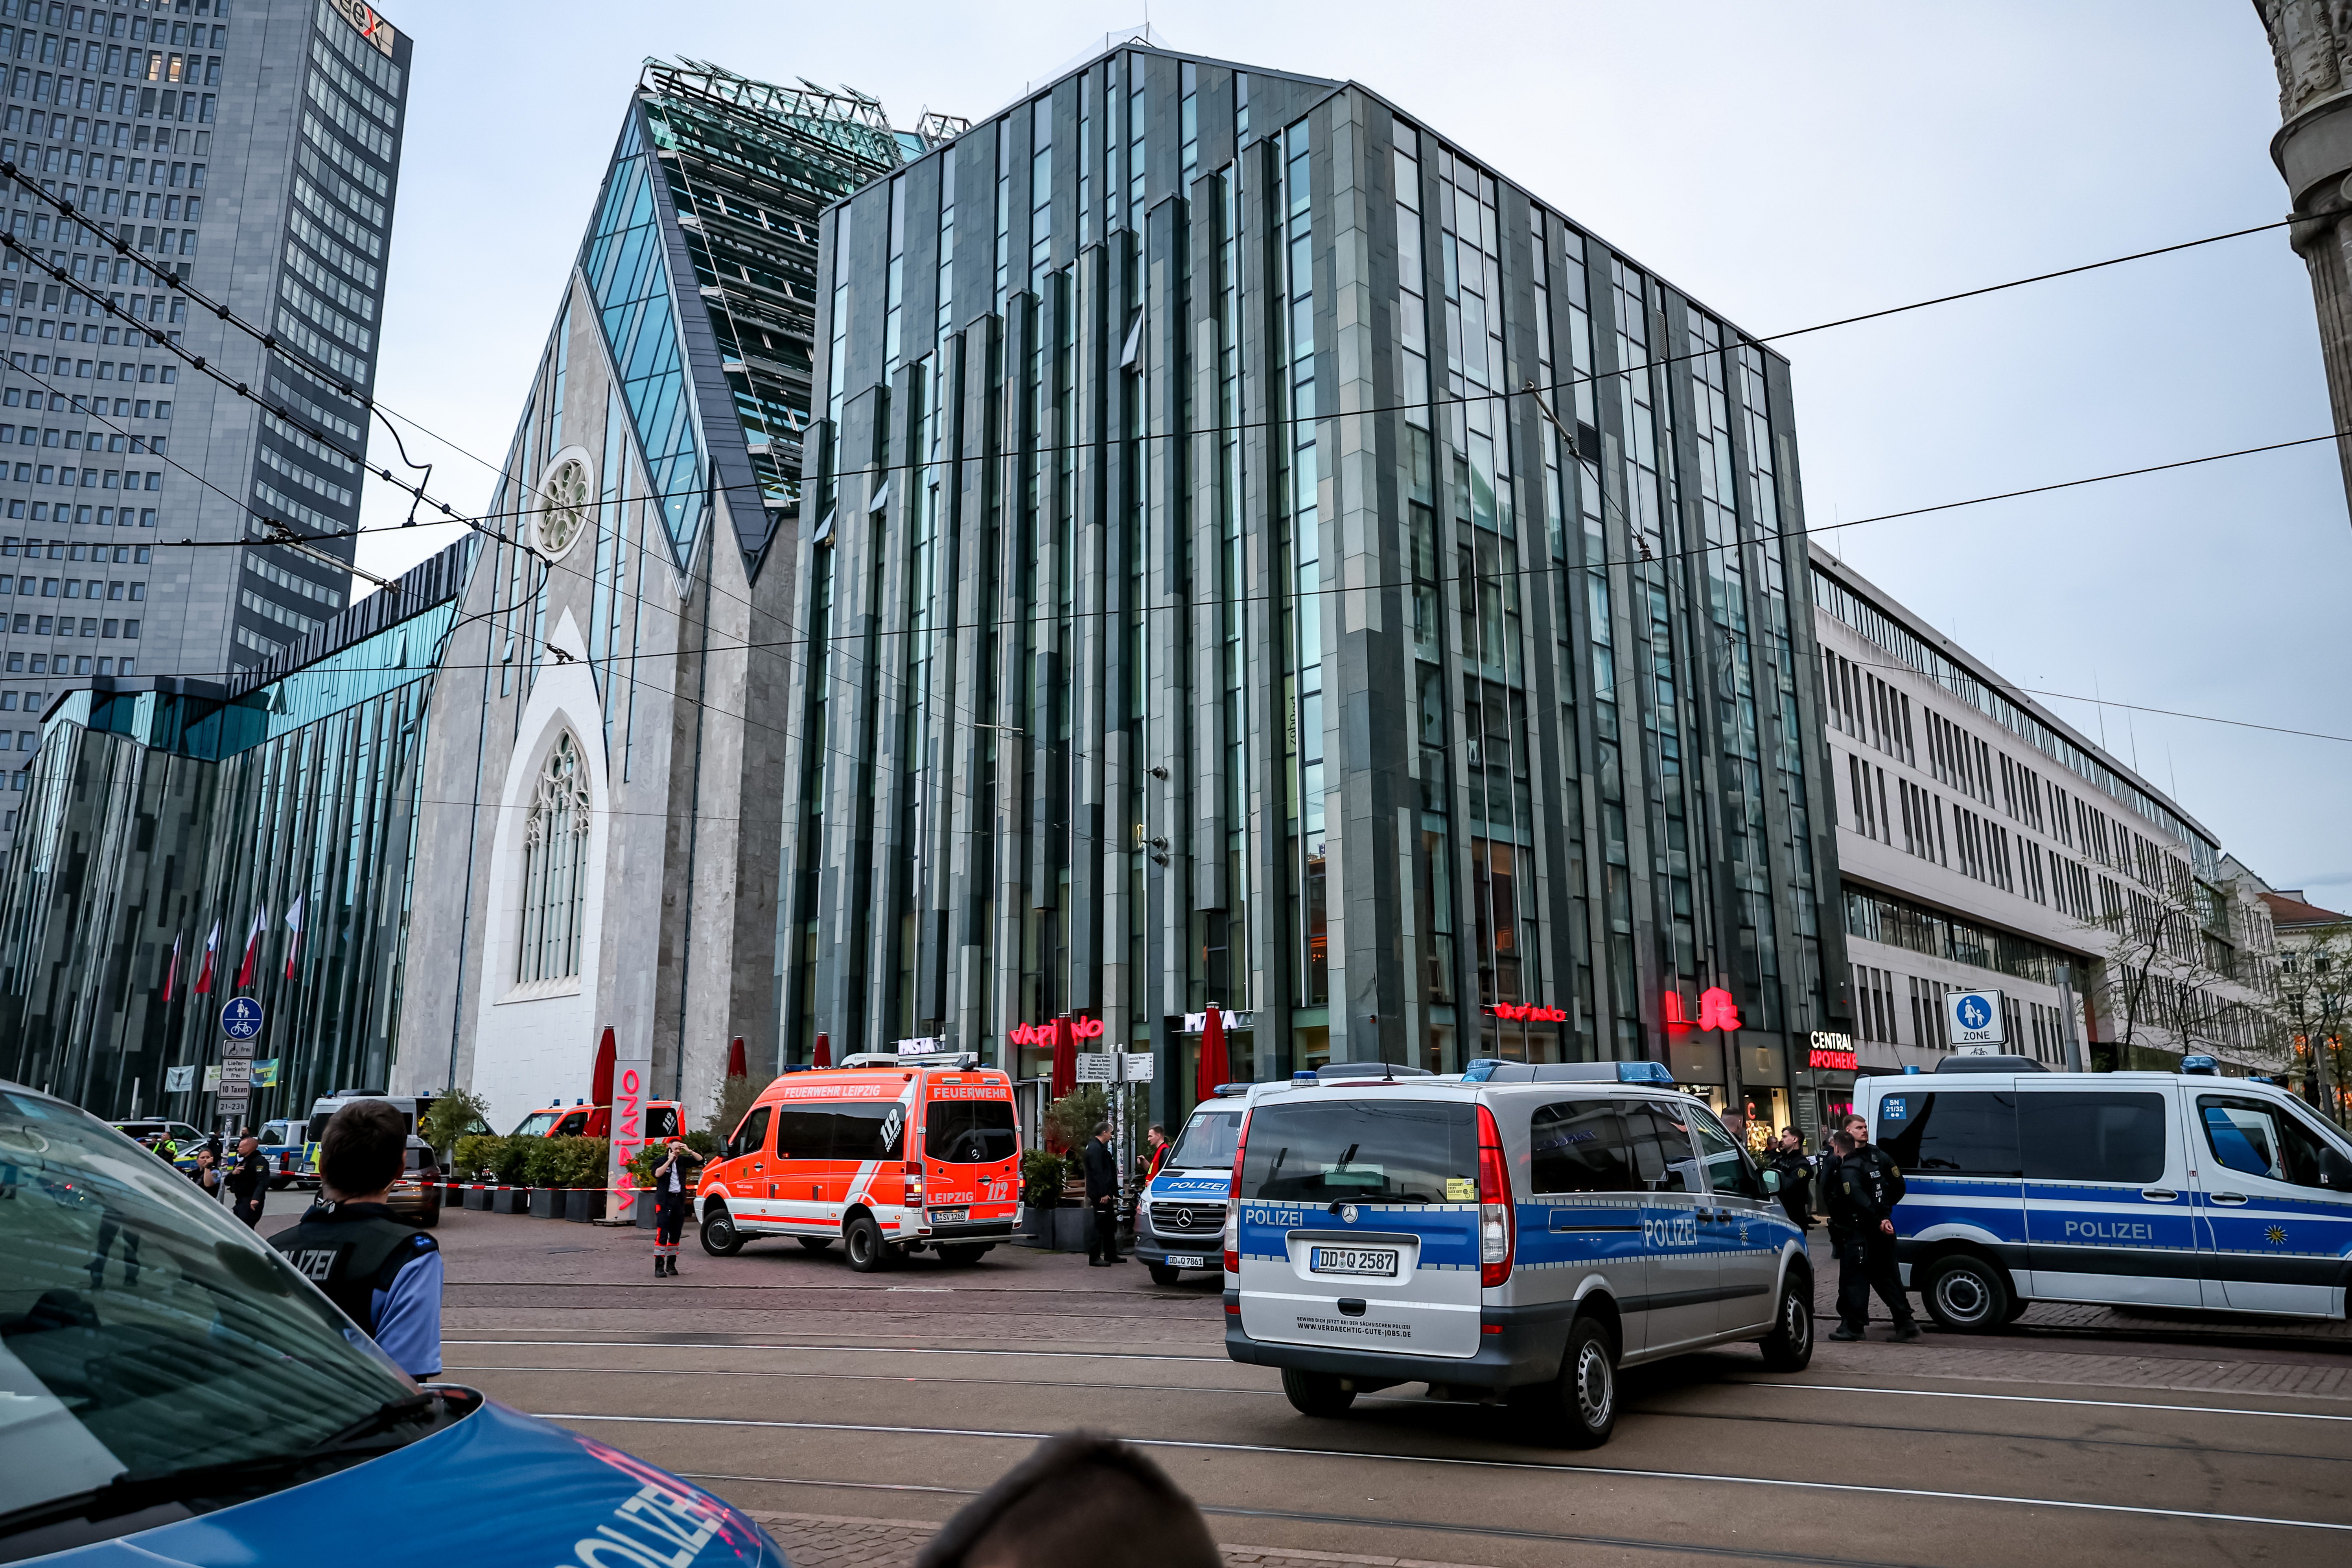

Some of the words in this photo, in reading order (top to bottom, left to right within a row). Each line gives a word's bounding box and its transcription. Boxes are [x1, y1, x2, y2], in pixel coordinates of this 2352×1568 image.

[1010, 1015, 1104, 1047] VAPINO
[1811, 1030, 1853, 1051] CENTRAL
[1963, 1031, 1990, 1040] ZONE
[898, 1037, 936, 1055] PASTA
[1809, 1050, 1858, 1070] APOTHEKE
[785, 1086, 841, 1098] FEUERWEHR
[842, 1085, 880, 1096] LEIPZIG
[934, 1087, 1007, 1098] FEUERWEHR
[663, 1112, 675, 1132] 112
[880, 1108, 901, 1147] 112
[886, 1124, 902, 1153] NOTRUF
[928, 1192, 974, 1203] LEIPZIG
[985, 1182, 1008, 1201] 112
[1167, 1182, 1228, 1191] POLIZEI
[1246, 1209, 1303, 1226] POLIZEI
[1645, 1219, 1698, 1247] POLIZEI
[2065, 1221, 2152, 1239] POLIZEI
[1321, 1251, 1338, 1267] DD
[1347, 1252, 1356, 1268] Q
[1359, 1253, 1393, 1270] 2587
[1297, 1323, 1411, 1338] WWW.VERDAECHTIG-GUTE-JOBS.DE
